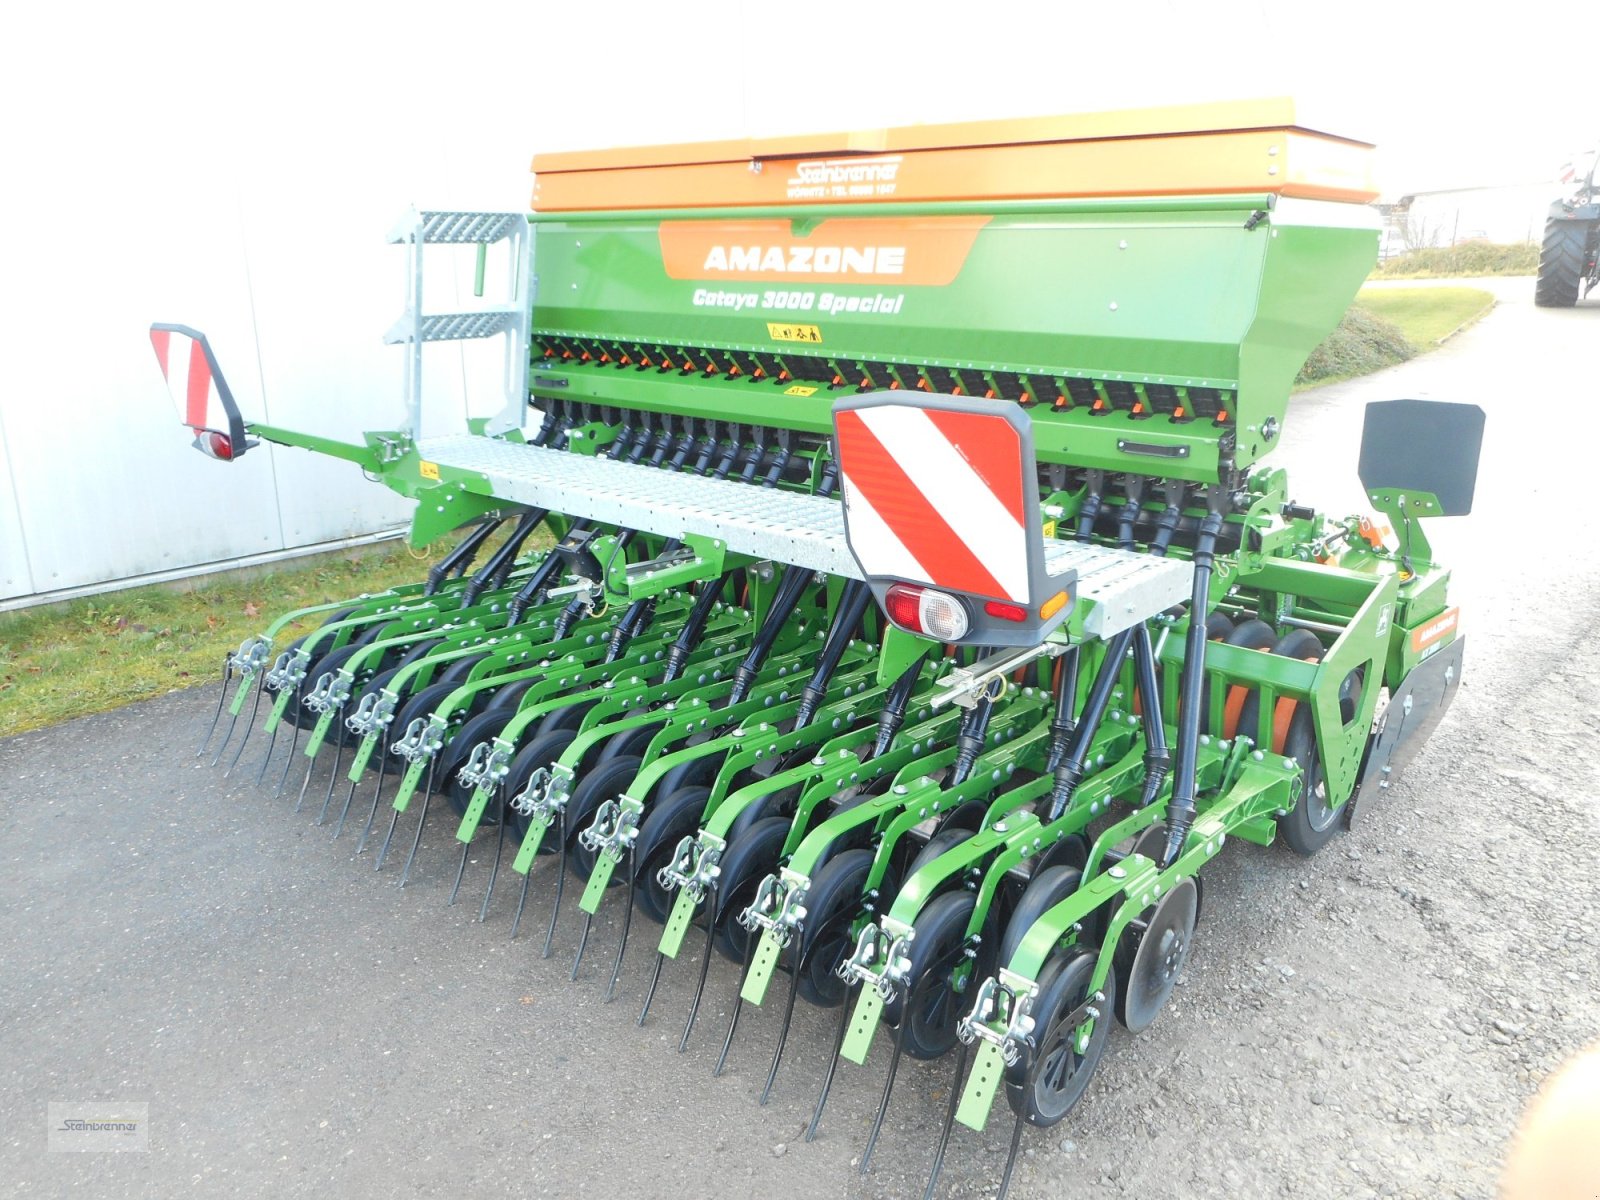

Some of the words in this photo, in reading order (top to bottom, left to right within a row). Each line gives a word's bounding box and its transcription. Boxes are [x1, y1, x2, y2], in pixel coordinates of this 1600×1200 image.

[788, 157, 901, 184] Steinbrenner
[703, 246, 906, 274] AMAZONE
[692, 288, 759, 311] Cataya
[761, 291, 815, 310] 3000
[817, 292, 904, 316] Special
